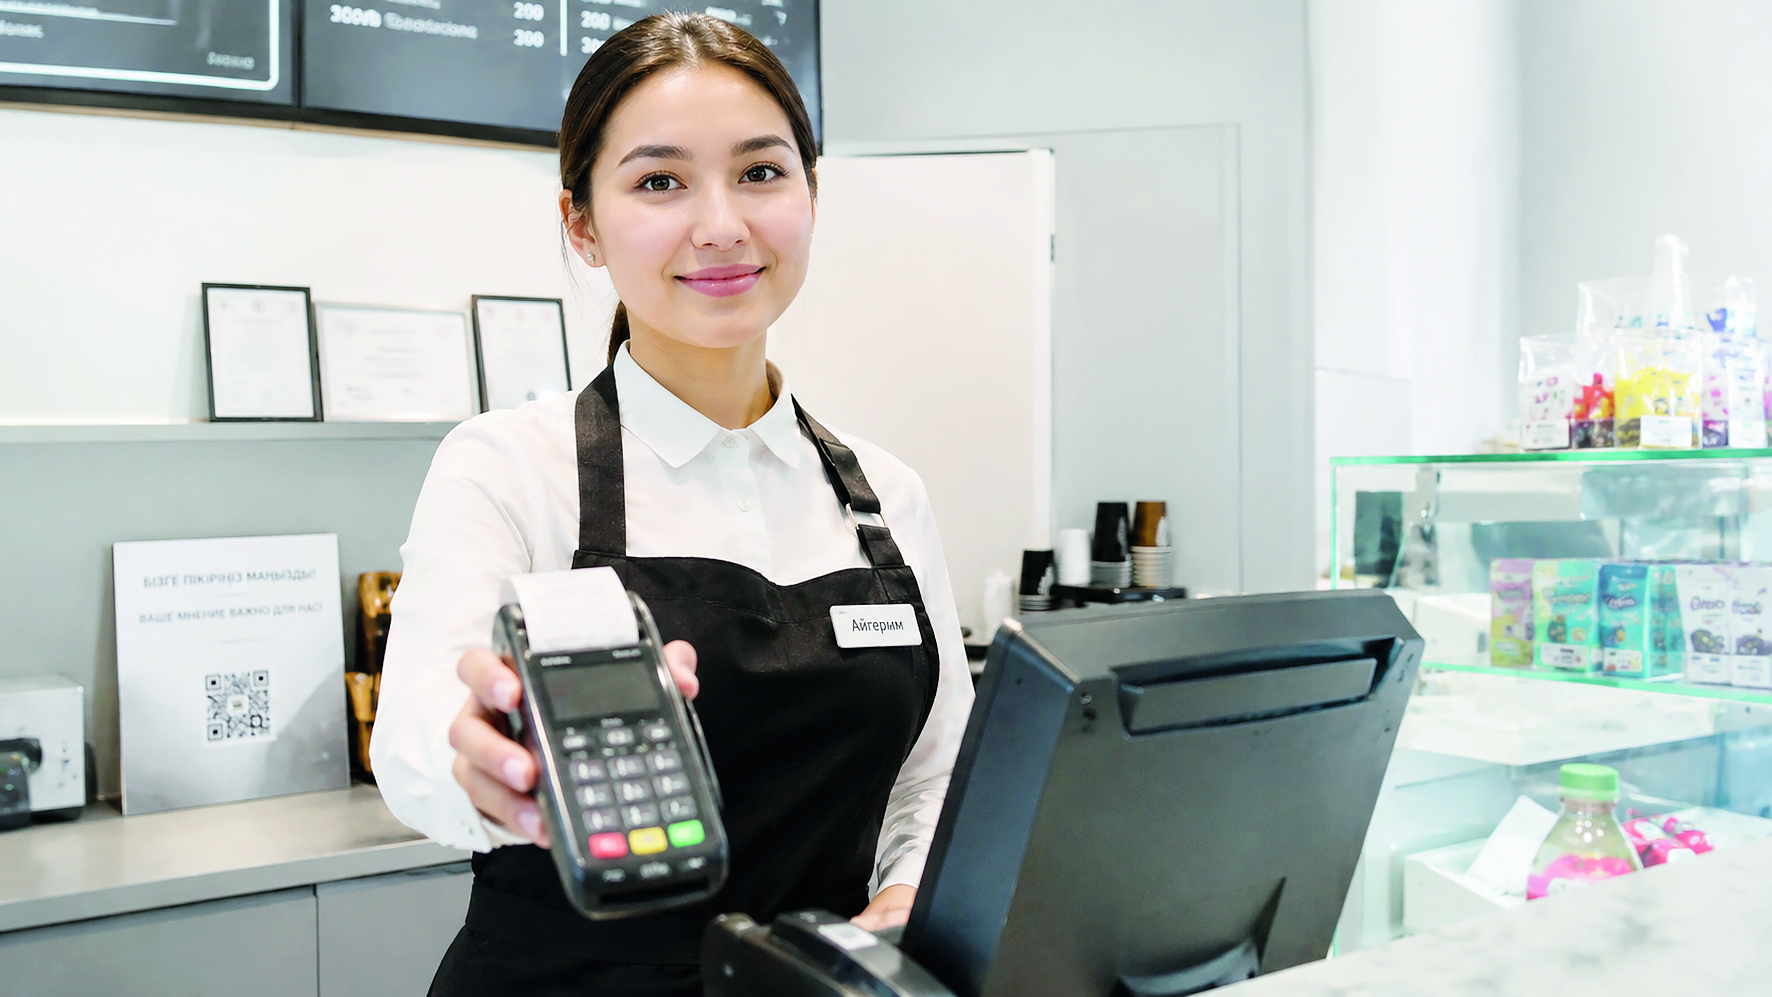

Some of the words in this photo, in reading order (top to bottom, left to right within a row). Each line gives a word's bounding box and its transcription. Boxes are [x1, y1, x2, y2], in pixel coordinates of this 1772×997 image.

[513, 1, 545, 22] 200
[513, 29, 545, 48] 300
[143, 573, 179, 588] БІЗГЕ
[183, 571, 242, 587] ПІКІРІҢІЗ
[246, 567, 316, 583] МАҢЫЗДЫ!
[139, 611, 174, 625] ВАШЕ
[178, 607, 226, 622] МНЕНИЕ
[229, 604, 270, 619] ВАЖНО
[273, 603, 295, 617] ДЛЯ
